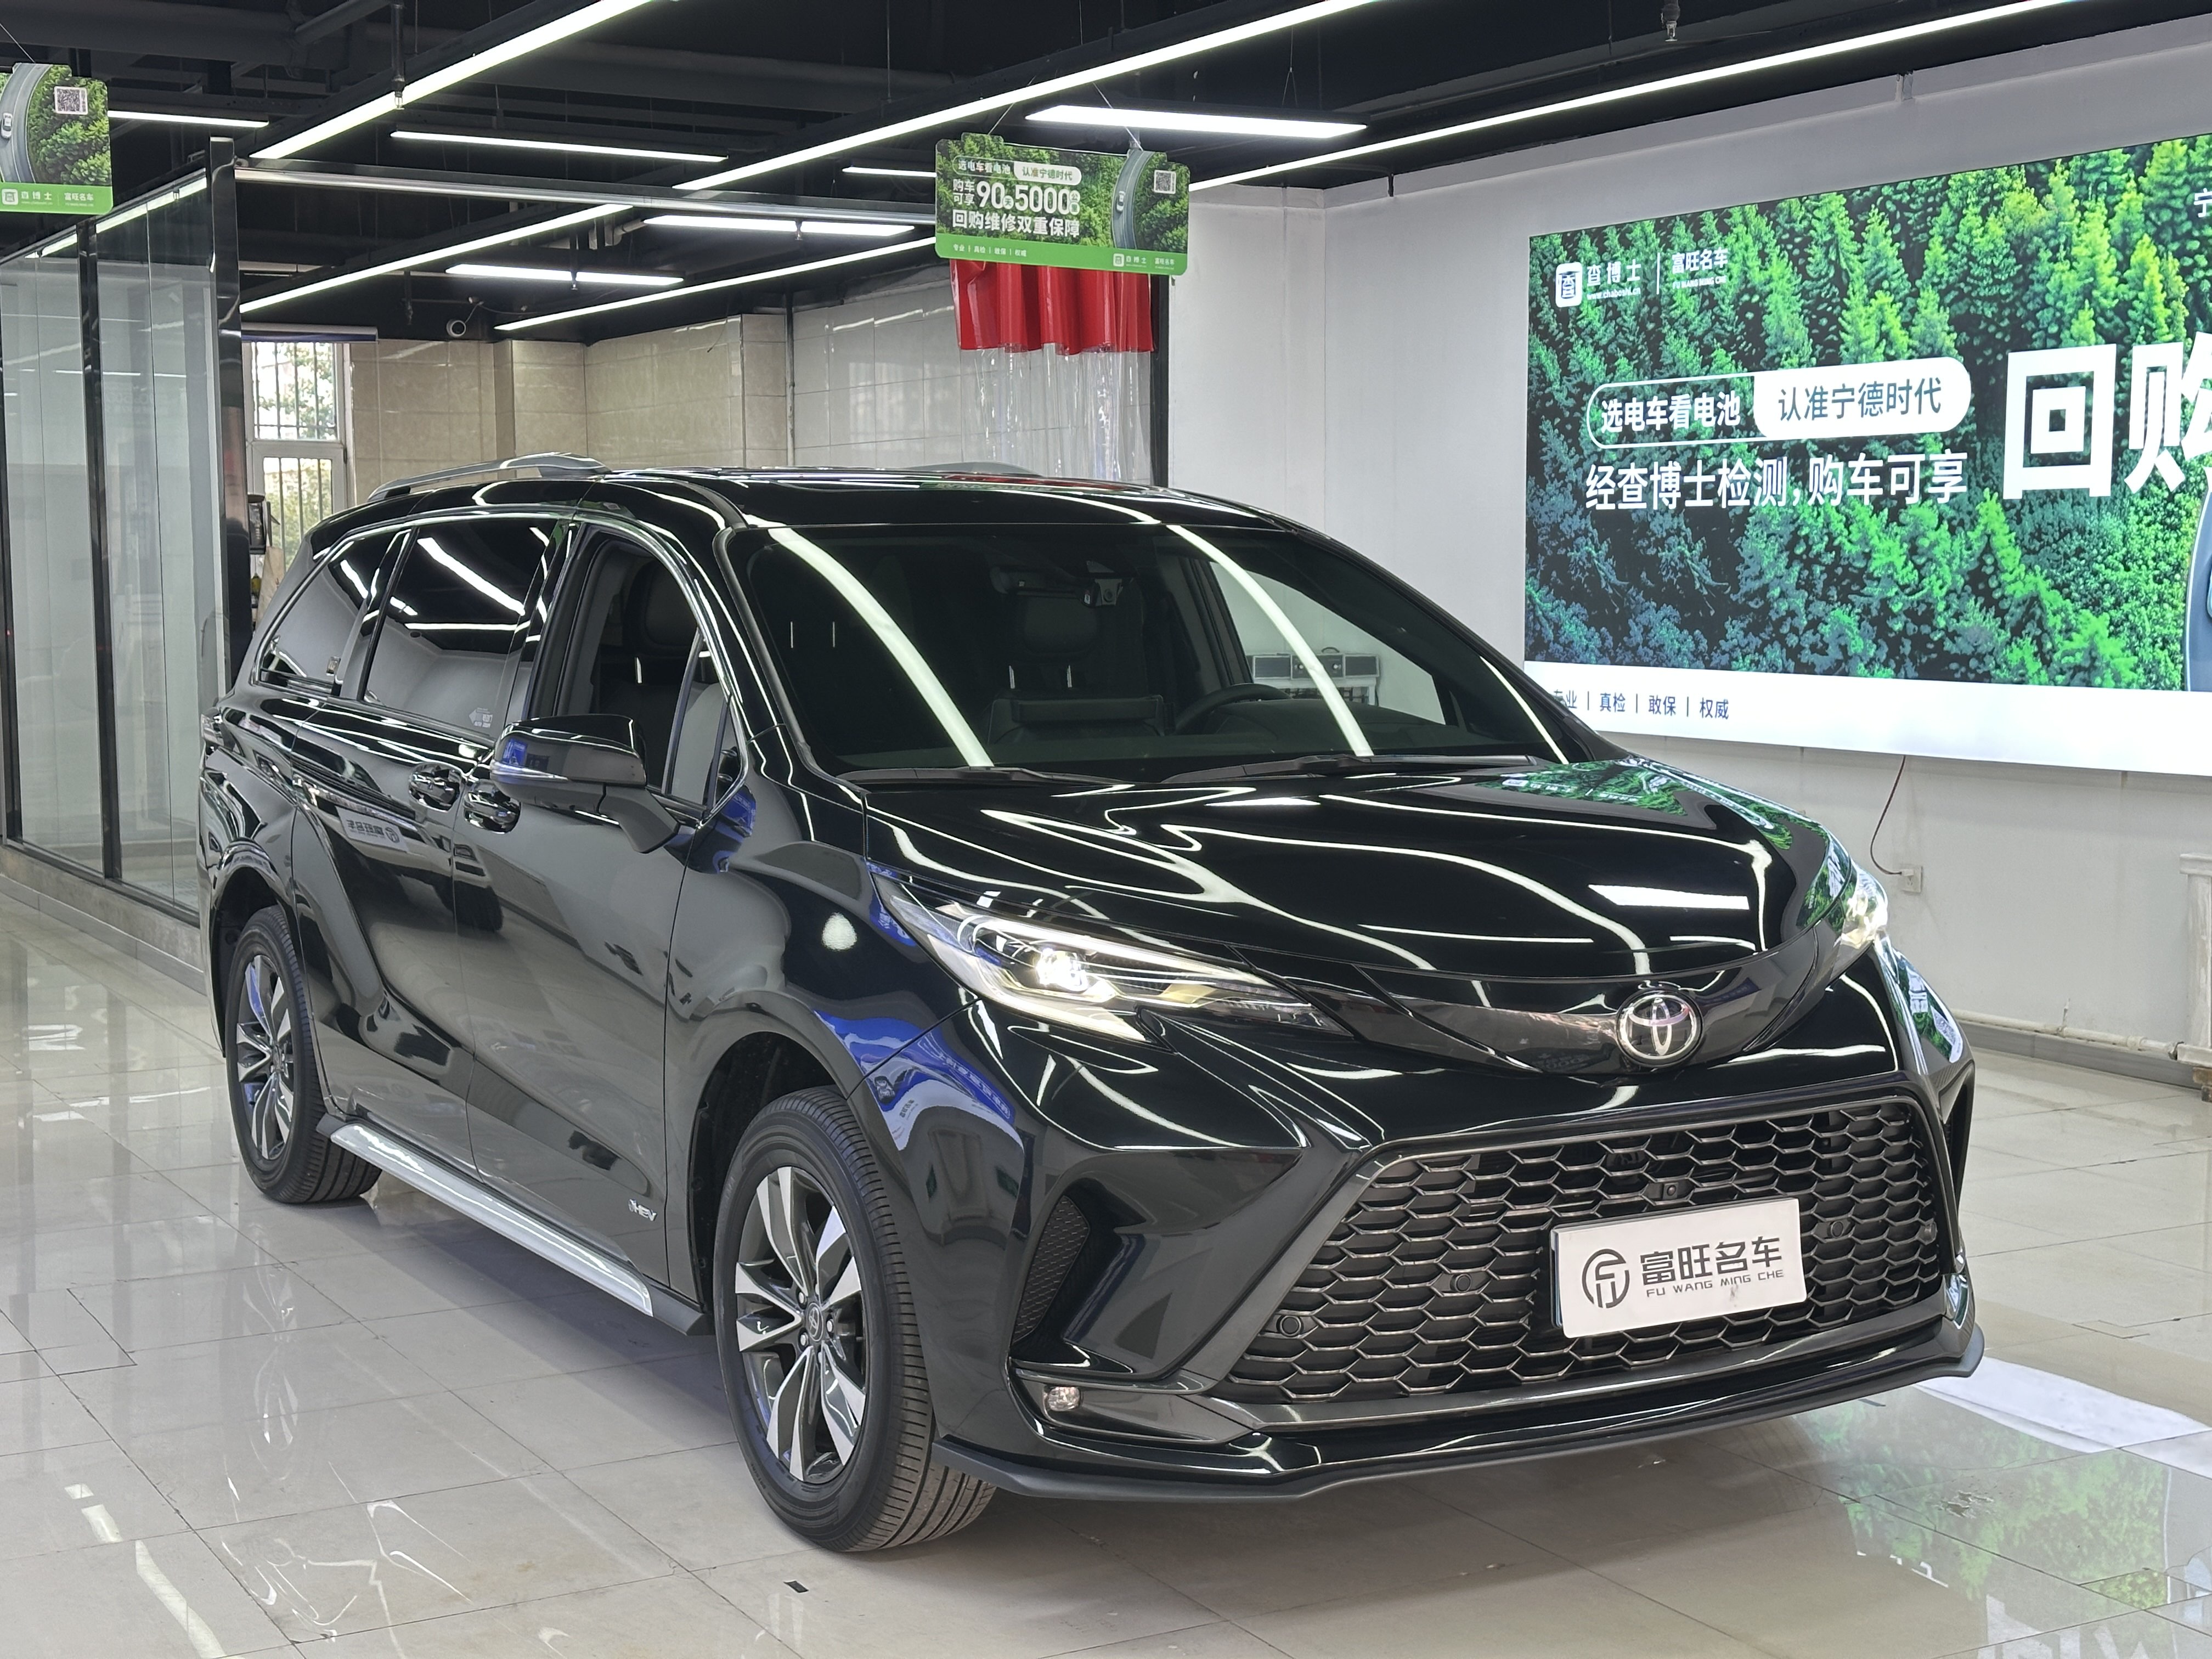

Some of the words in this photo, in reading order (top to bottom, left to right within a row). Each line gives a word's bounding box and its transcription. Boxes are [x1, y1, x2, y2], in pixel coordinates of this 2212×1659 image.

[953, 179, 974, 192] 购车
[1023, 166, 1073, 180] 认准宁德时代
[953, 192, 974, 206] 可享
[952, 209, 1080, 238] 回购维修双重保障
[1587, 258, 1641, 286] 查博士
[1672, 247, 1728, 274] 富旺名车
[1600, 391, 1741, 433] 选电车看电池
[1778, 377, 1942, 422] 认准宁德时代
[1599, 692, 1626, 713] 真检
[1649, 695, 1676, 716] 敢保
[1699, 697, 1729, 720] 权威
[1640, 1235, 1782, 1286] 富旺名车
[1646, 1286, 1666, 1298] FU
[1673, 1280, 1713, 1294] WANG
[1720, 1274, 1751, 1286] MING
[1758, 1269, 1785, 1281] CHE
